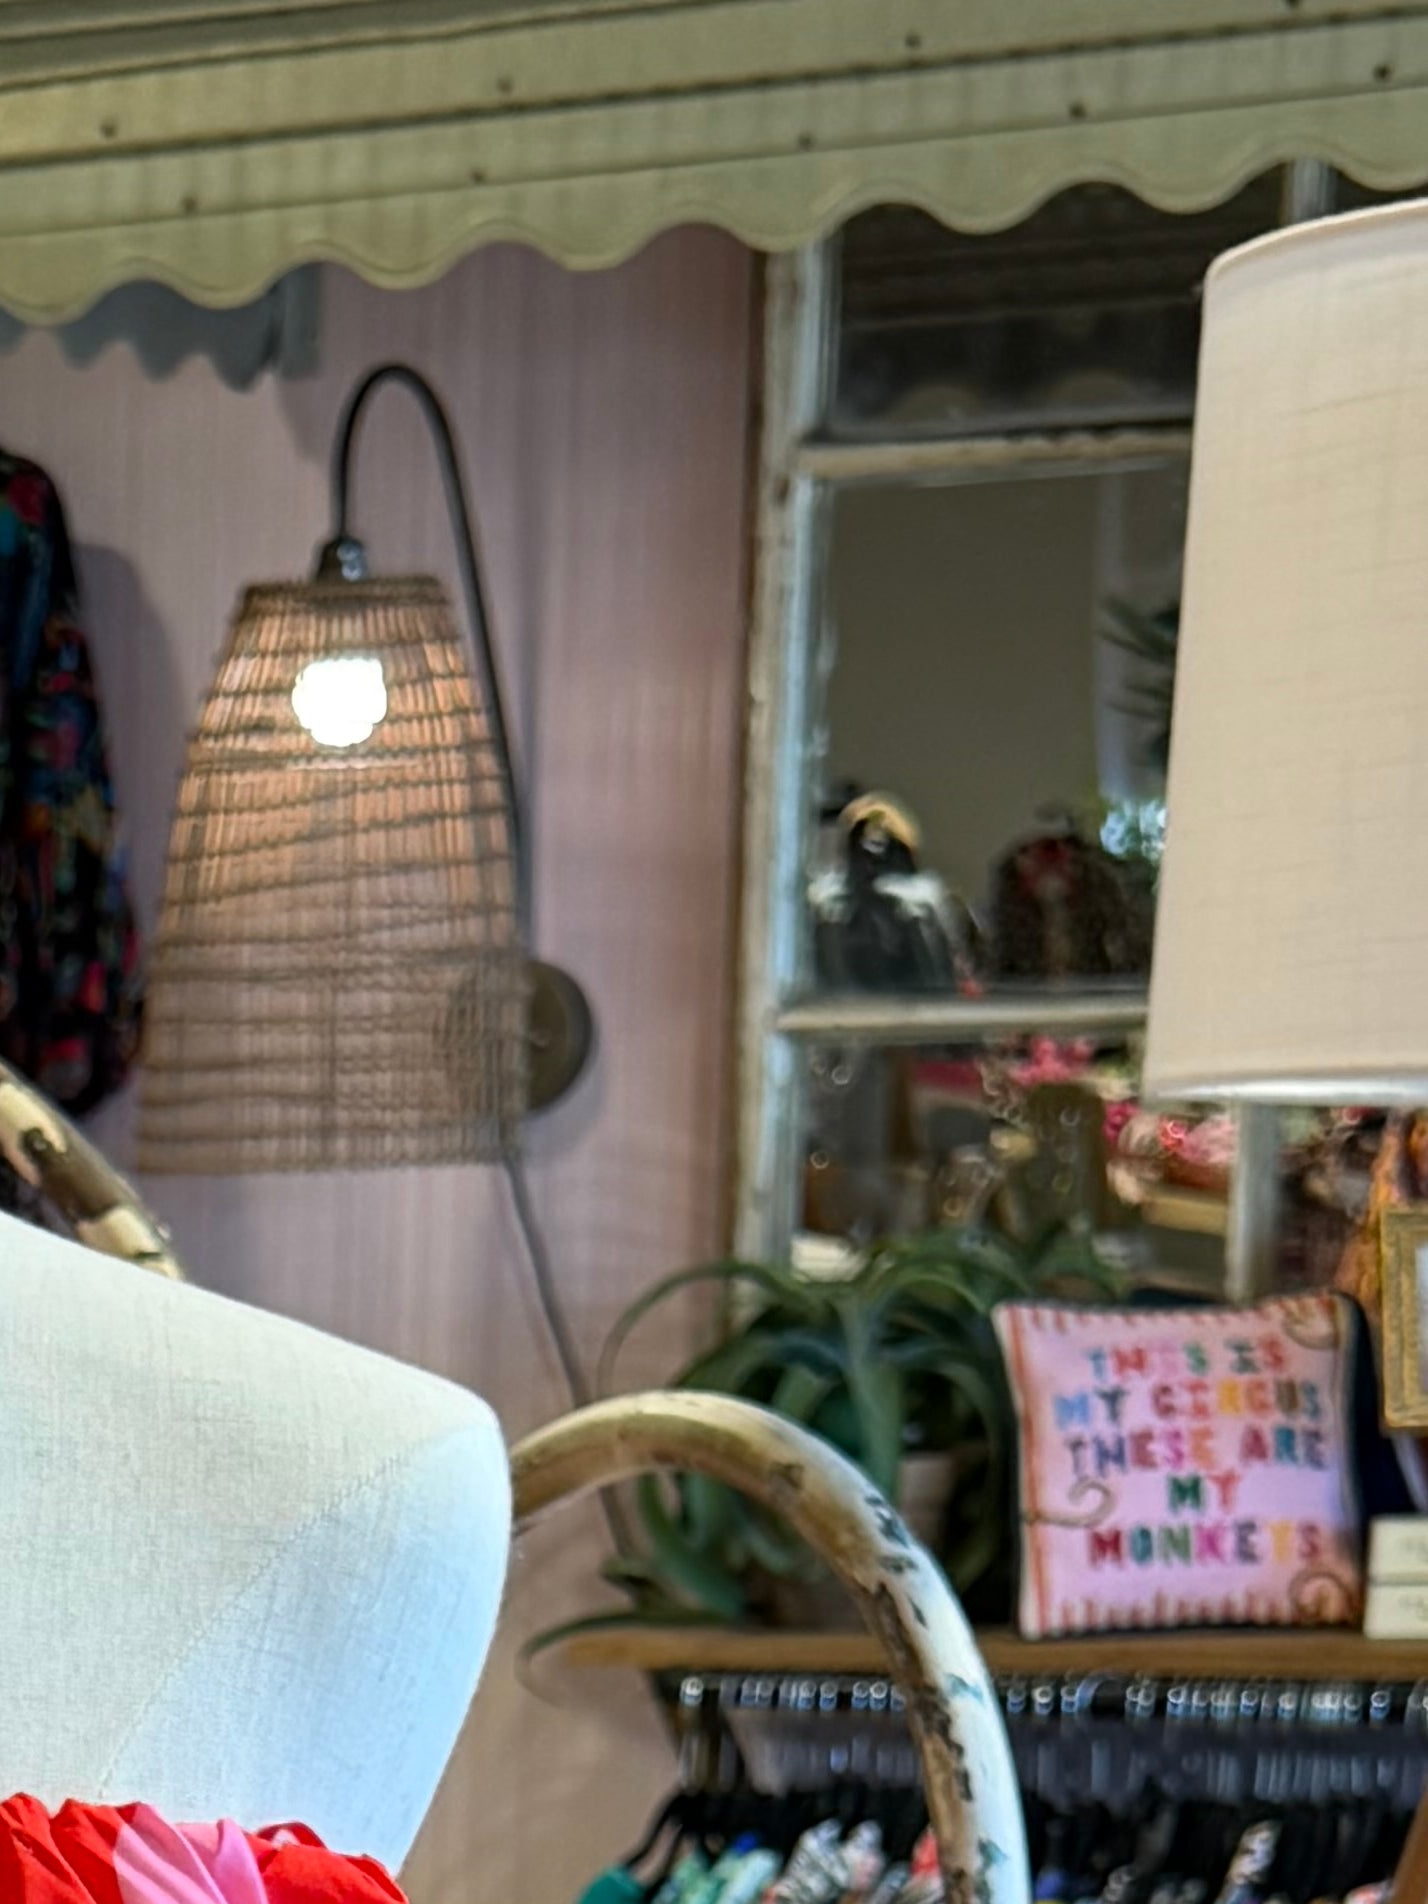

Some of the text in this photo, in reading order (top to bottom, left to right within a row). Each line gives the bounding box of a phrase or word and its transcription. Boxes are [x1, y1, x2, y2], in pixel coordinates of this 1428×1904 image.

[1087, 1336, 1286, 1380] THIS IS
[1054, 1378, 1321, 1430] MY CIRCUS
[1066, 1425, 1326, 1477] THESE ARE
[1167, 1470, 1239, 1514] MY
[1089, 1519, 1322, 1568] MONKEYS
